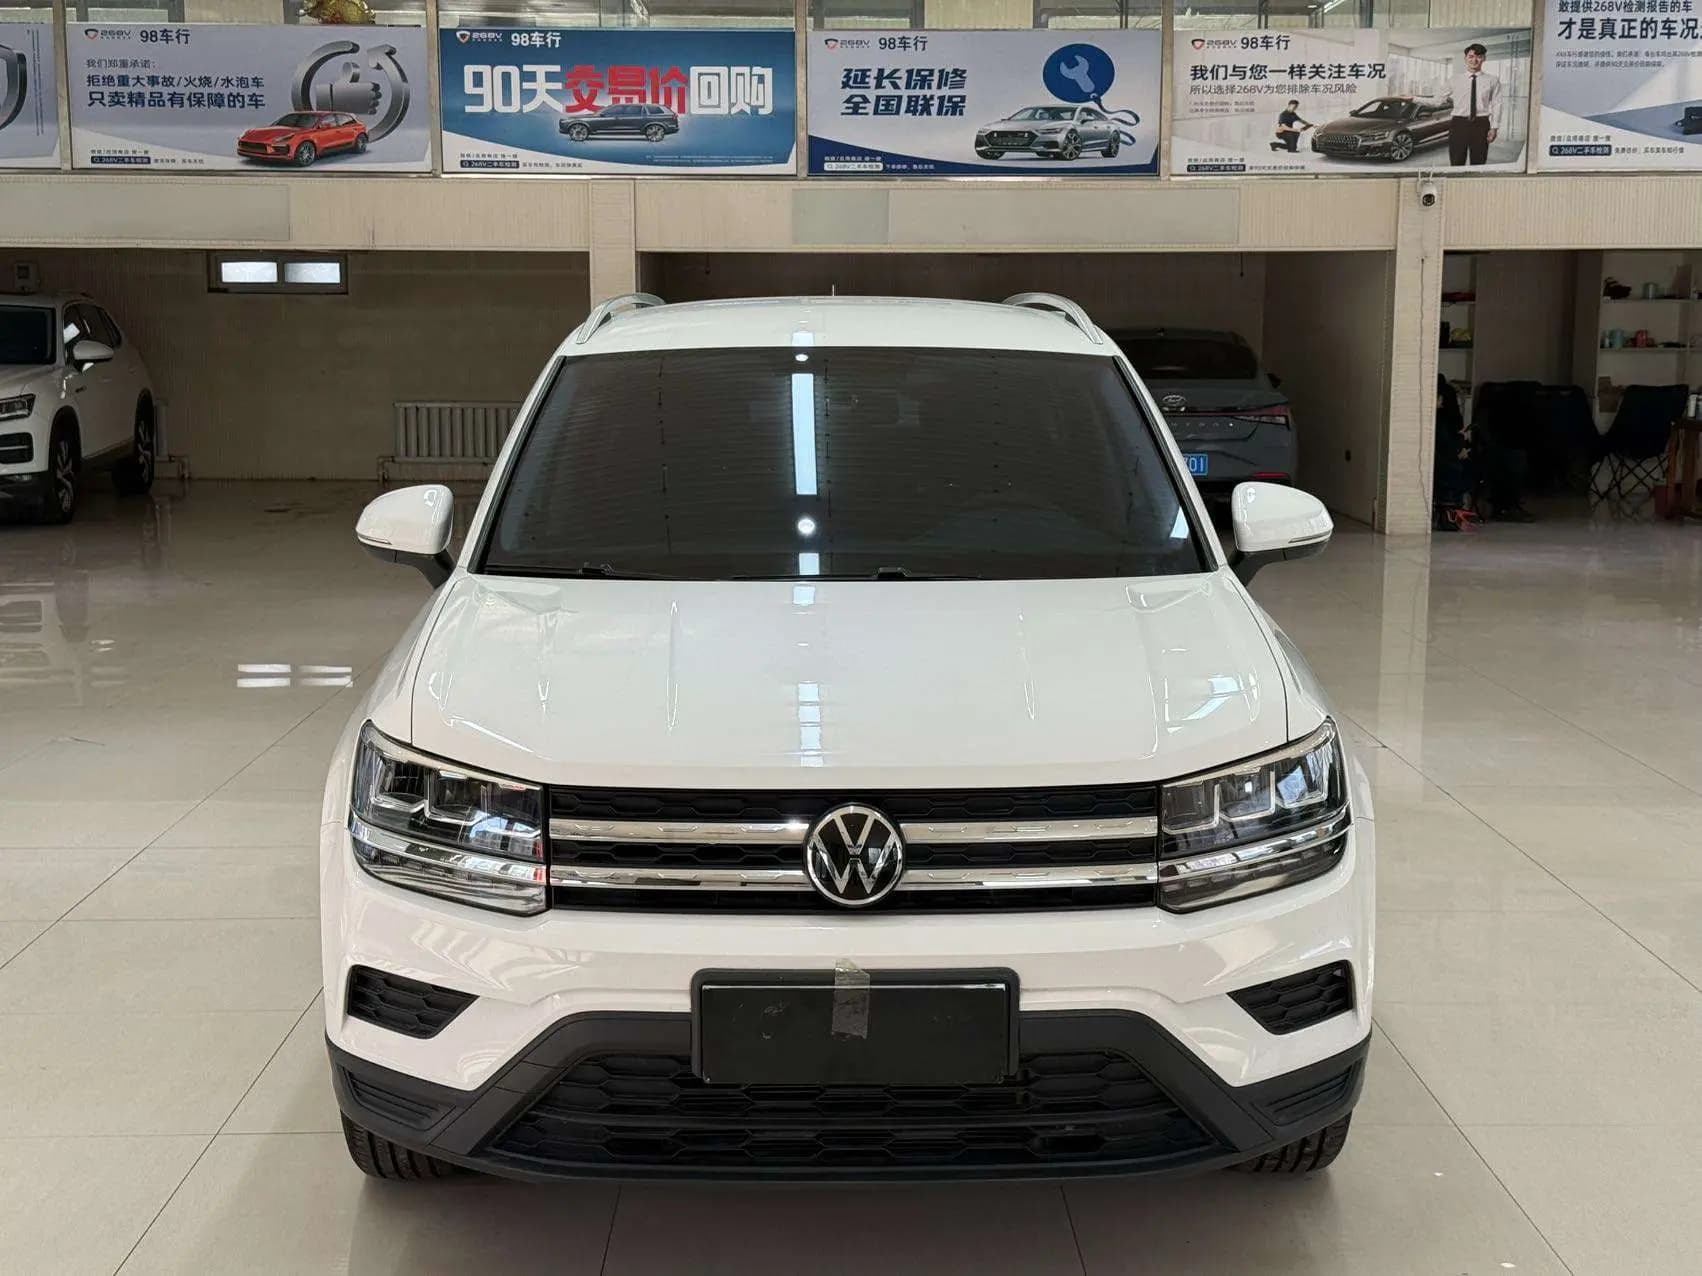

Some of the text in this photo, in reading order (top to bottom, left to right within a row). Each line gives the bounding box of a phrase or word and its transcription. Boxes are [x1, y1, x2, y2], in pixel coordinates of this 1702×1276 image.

[139, 28, 191, 45] 98车行
[1557, 17, 1702, 40] 才是真正的车况
[511, 32, 562, 48] 98车行
[878, 36, 928, 52] 98车行
[1240, 35, 1291, 51] 98车行
[840, 67, 968, 91] 延长保修
[1190, 63, 1387, 81] 我们与您一样关注车况
[86, 74, 265, 89] 拒绝重大事故/火烧/水泡车
[1189, 83, 1357, 96] 所以选择268V为您排除车况风险
[88, 91, 266, 109] 只卖精品有保障的车
[840, 94, 967, 117] 全国联保
